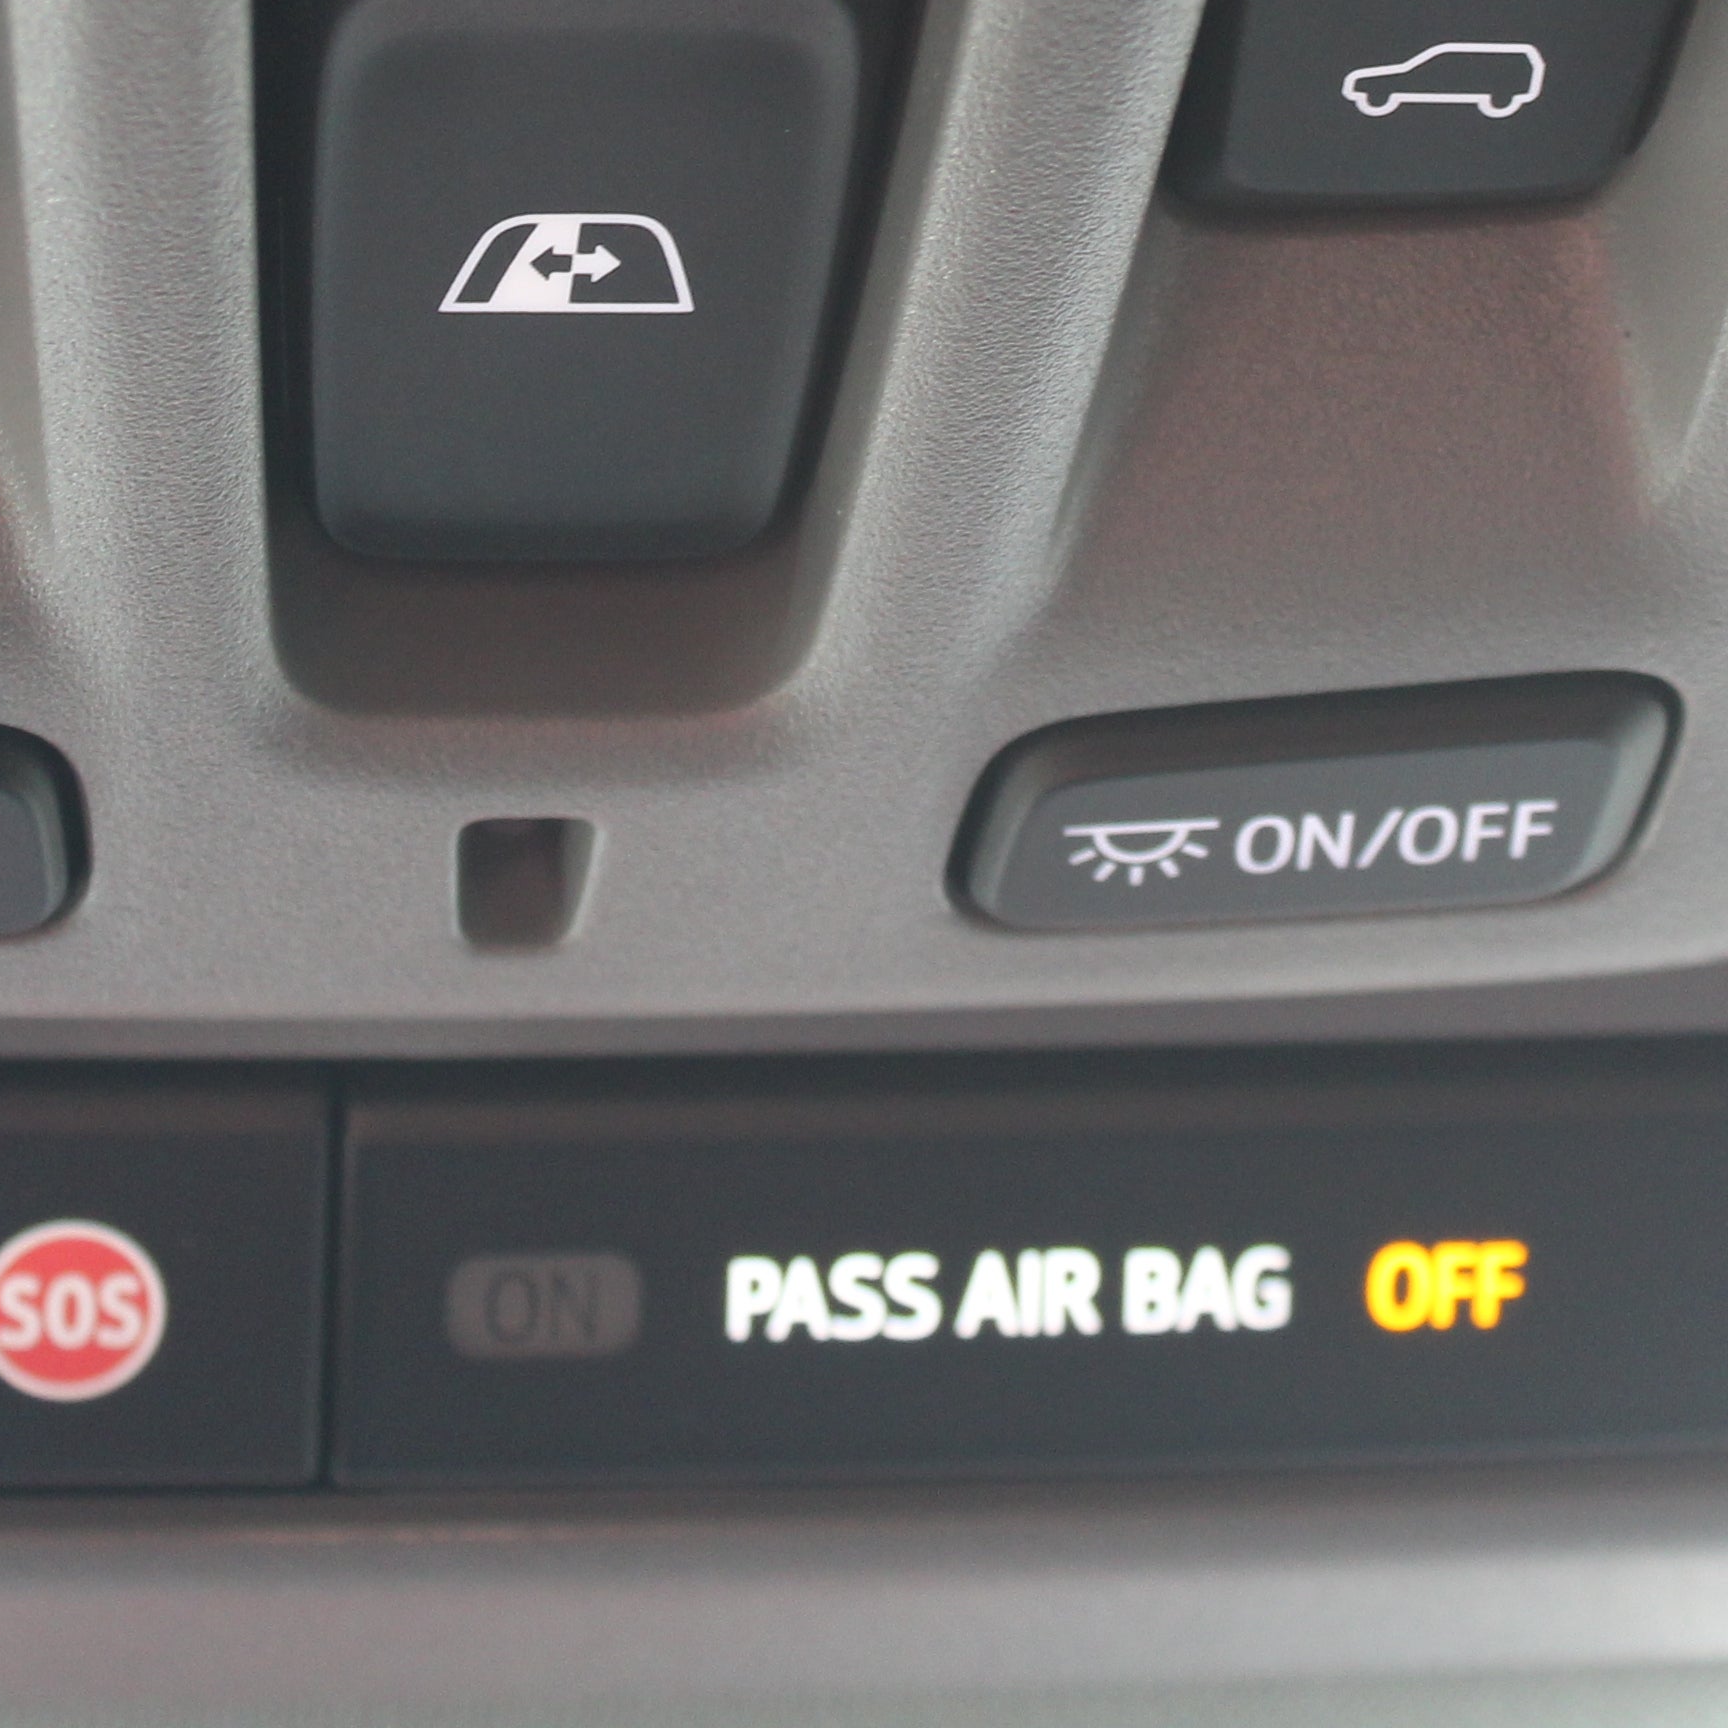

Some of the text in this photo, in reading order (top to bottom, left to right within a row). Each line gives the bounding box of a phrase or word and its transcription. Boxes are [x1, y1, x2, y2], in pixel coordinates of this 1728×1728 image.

[1233, 799, 1559, 875] ON/OFF
[485, 1270, 604, 1345] ON
[725, 1239, 1530, 1343] PASS AIR BAG OFF
